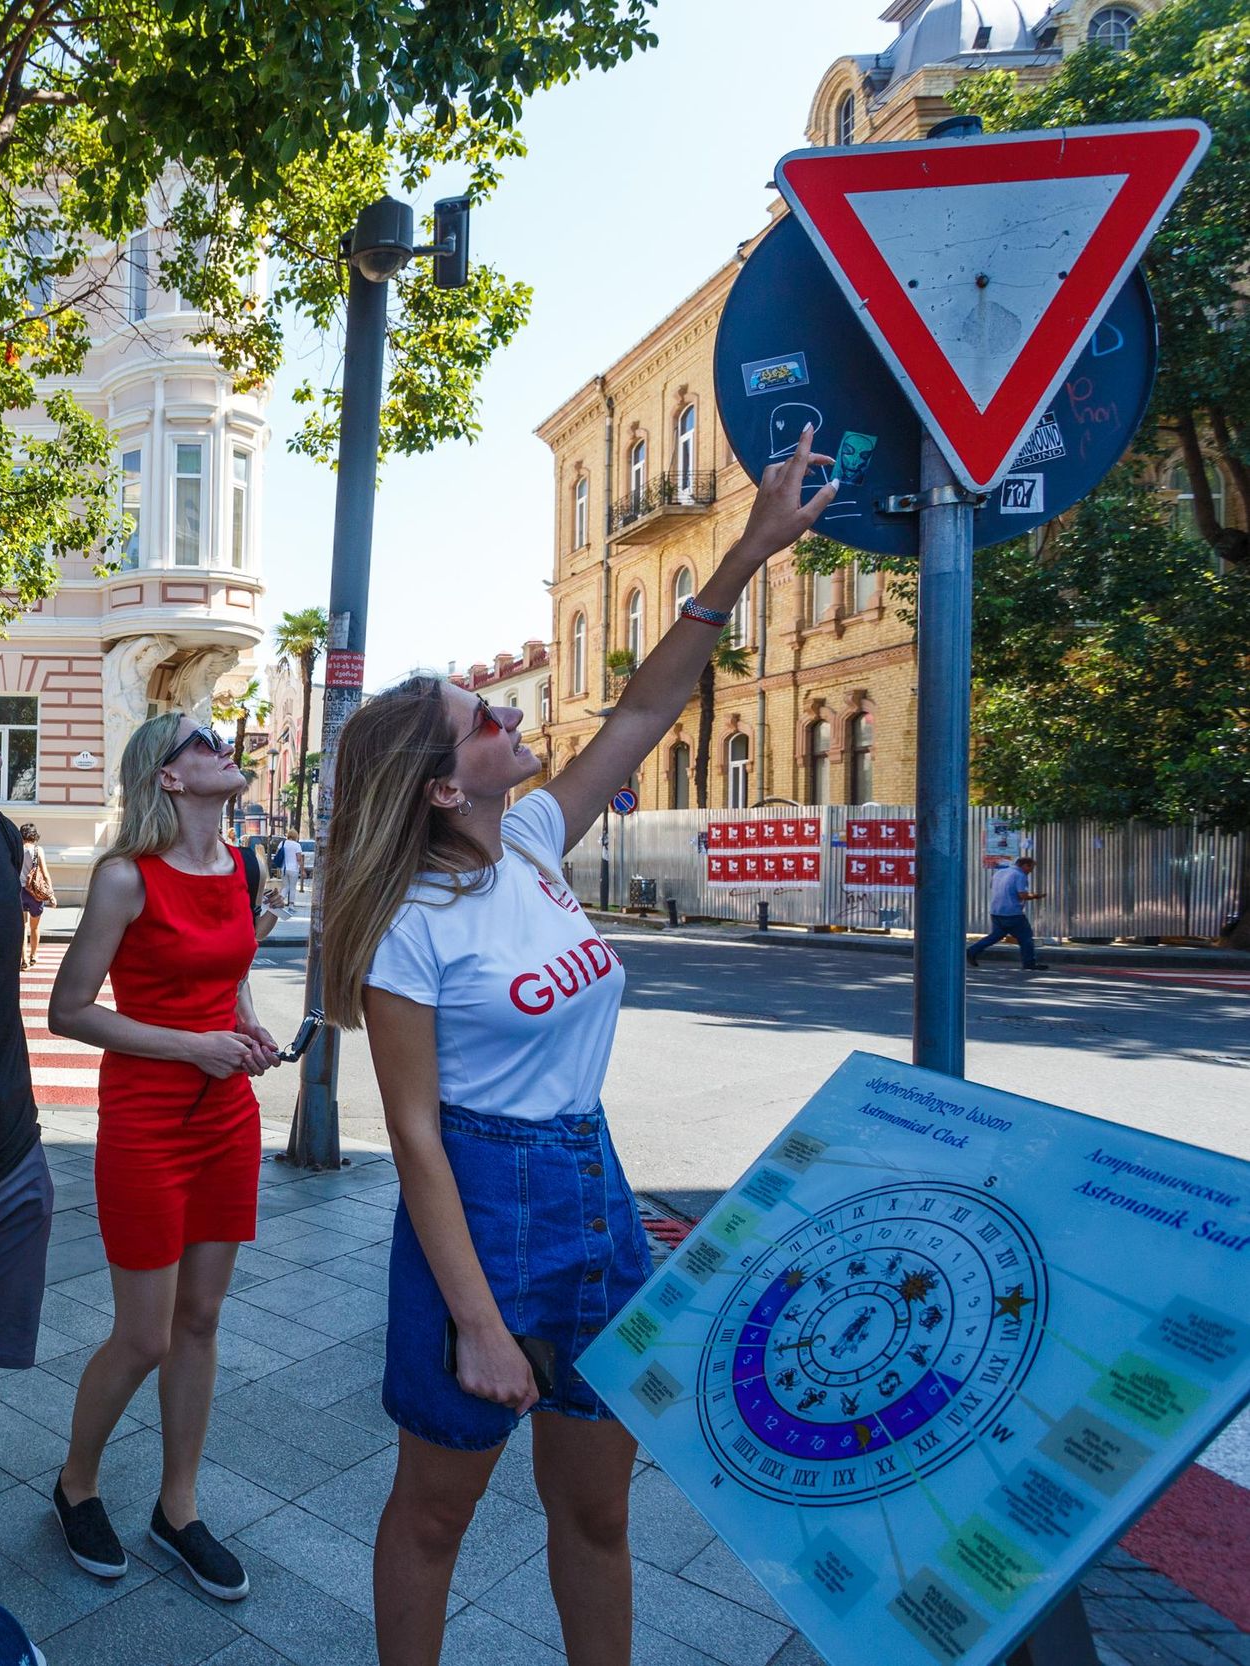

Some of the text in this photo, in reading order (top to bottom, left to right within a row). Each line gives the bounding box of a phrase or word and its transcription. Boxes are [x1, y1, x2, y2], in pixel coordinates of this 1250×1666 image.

[509, 930, 622, 1016] GUID
[857, 1102, 971, 1150] Astronomical Clock
[966, 1106, 1014, 1133] საათი
[983, 1175, 998, 1188] S
[1083, 1148, 1240, 1208] Астрономические
[919, 1197, 936, 1212] XI
[1073, 1180, 1190, 1230] Astronomik
[949, 1206, 972, 1224] XII
[876, 1227, 892, 1240] 10
[903, 1228, 919, 1241] 11
[976, 1222, 1002, 1244] XIII
[927, 1236, 944, 1250] 12
[739, 1255, 753, 1268] E
[952, 1252, 962, 1263] 1
[961, 1271, 976, 1284] 2
[968, 1296, 981, 1309] 3
[964, 1325, 978, 1337] 4
[951, 1353, 966, 1366] 5
[764, 1415, 779, 1431] 12
[786, 1429, 800, 1444] 11
[810, 1434, 826, 1450] 10
